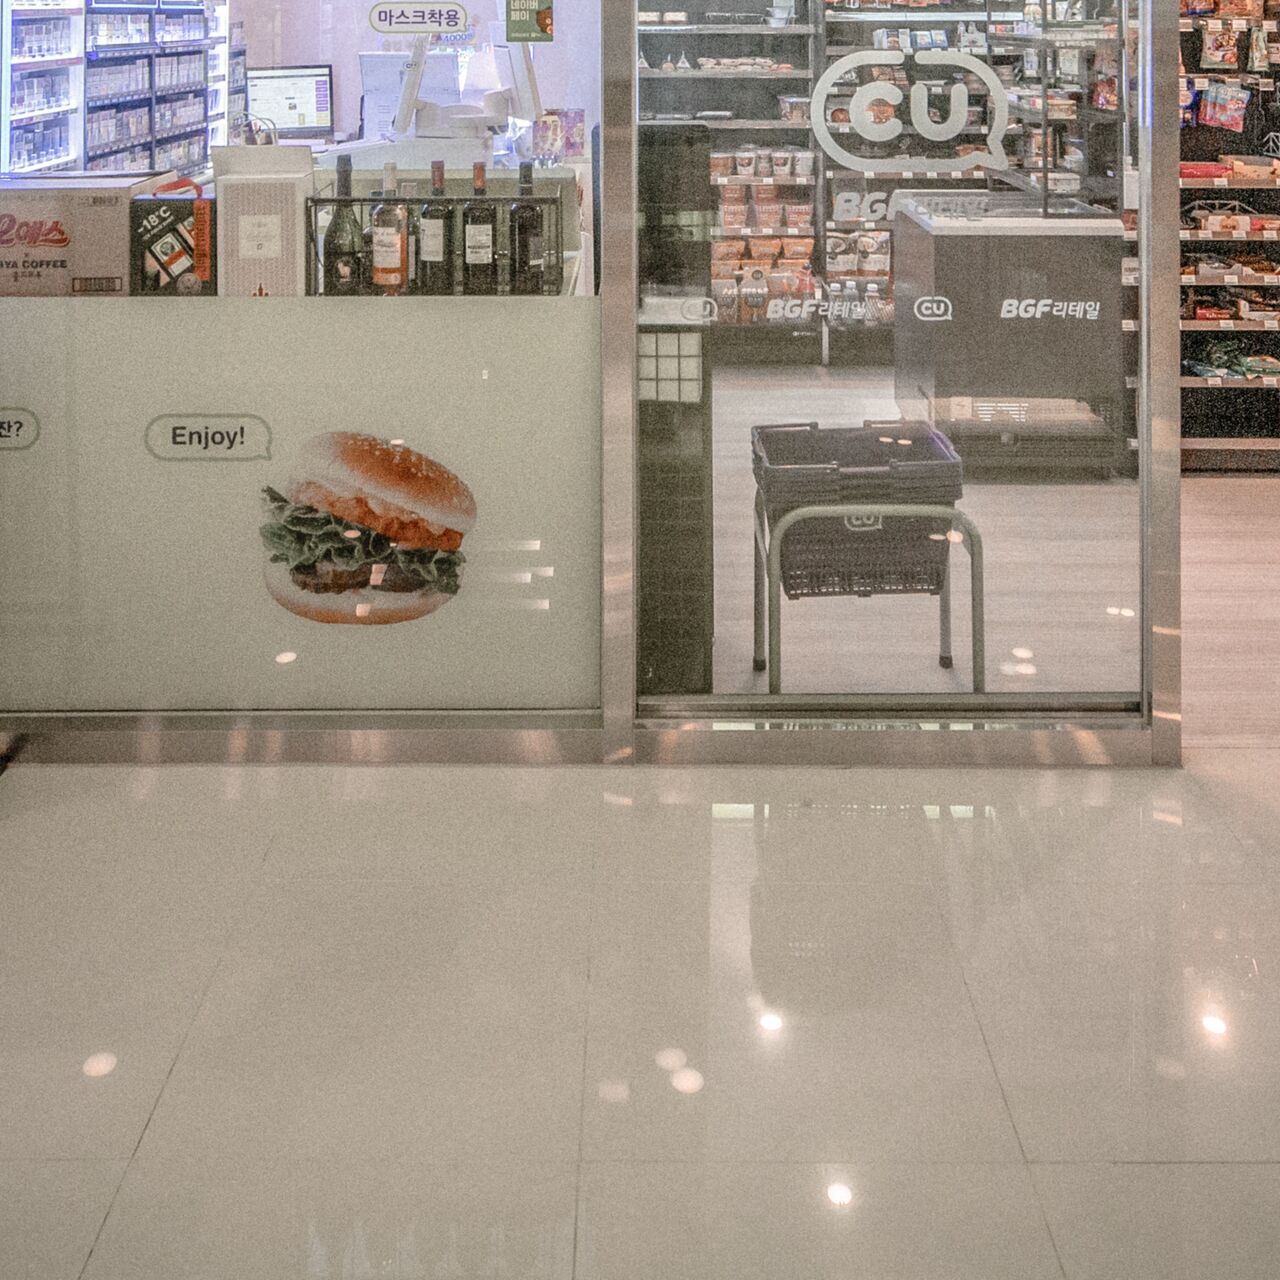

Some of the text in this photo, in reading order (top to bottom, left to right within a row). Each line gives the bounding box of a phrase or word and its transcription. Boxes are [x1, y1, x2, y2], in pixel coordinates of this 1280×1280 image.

[510, 0, 539, 10] 네이버
[378, 8, 461, 28] 마스크착용
[510, 10, 530, 21] 페이
[849, 81, 969, 142] CU
[22, 259, 68, 269] COFFEE
[920, 302, 945, 315] CU
[1000, 298, 1101, 320] BGF리테일
[171, 425, 245, 450] Enjoy!
